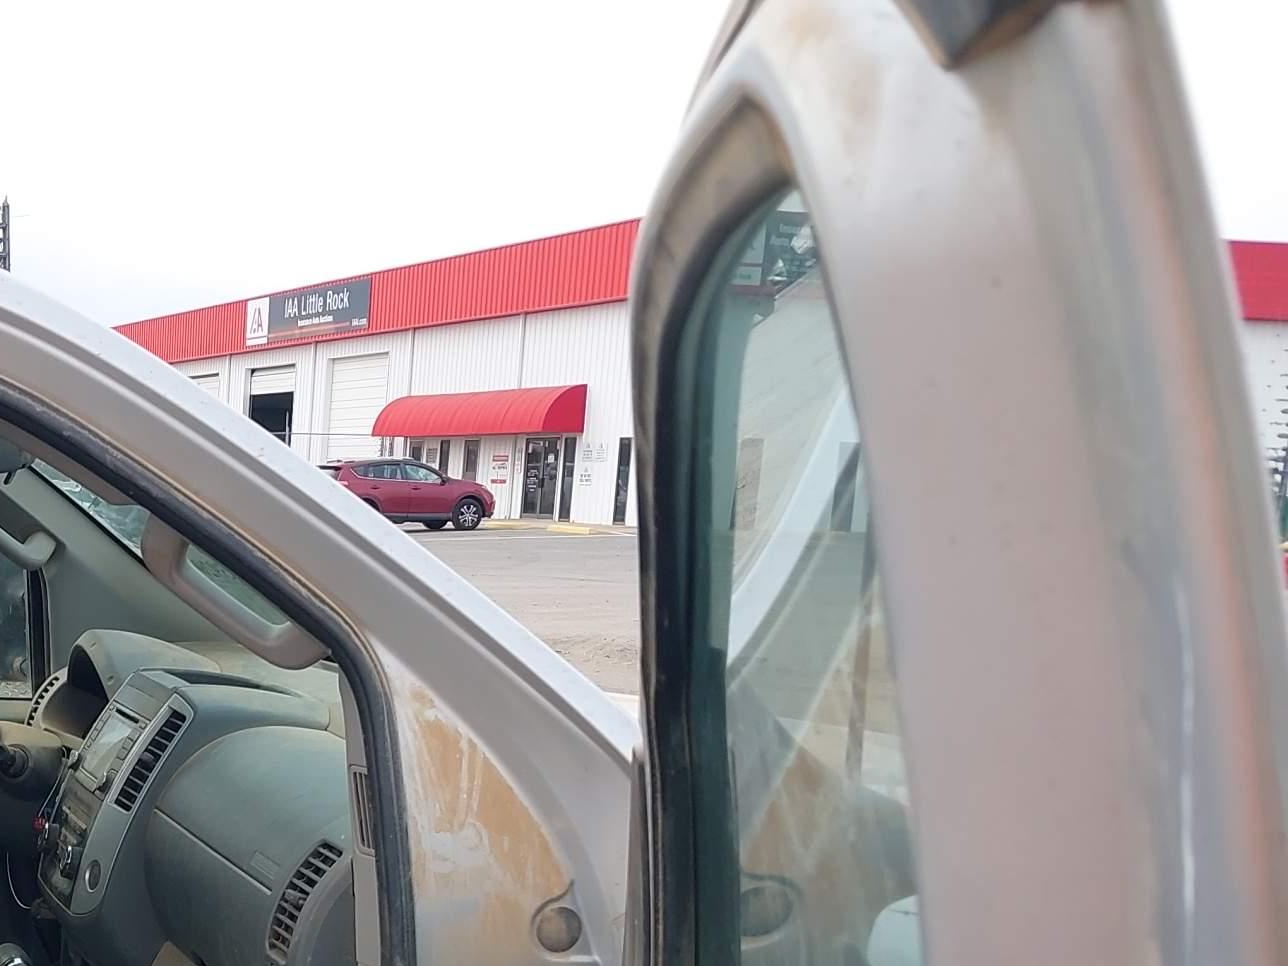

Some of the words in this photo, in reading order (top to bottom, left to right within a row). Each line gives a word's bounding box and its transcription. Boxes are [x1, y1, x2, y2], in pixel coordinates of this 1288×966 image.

[284, 297, 299, 318] IAA
[301, 293, 324, 316] Little
[326, 288, 350, 311] Rock
